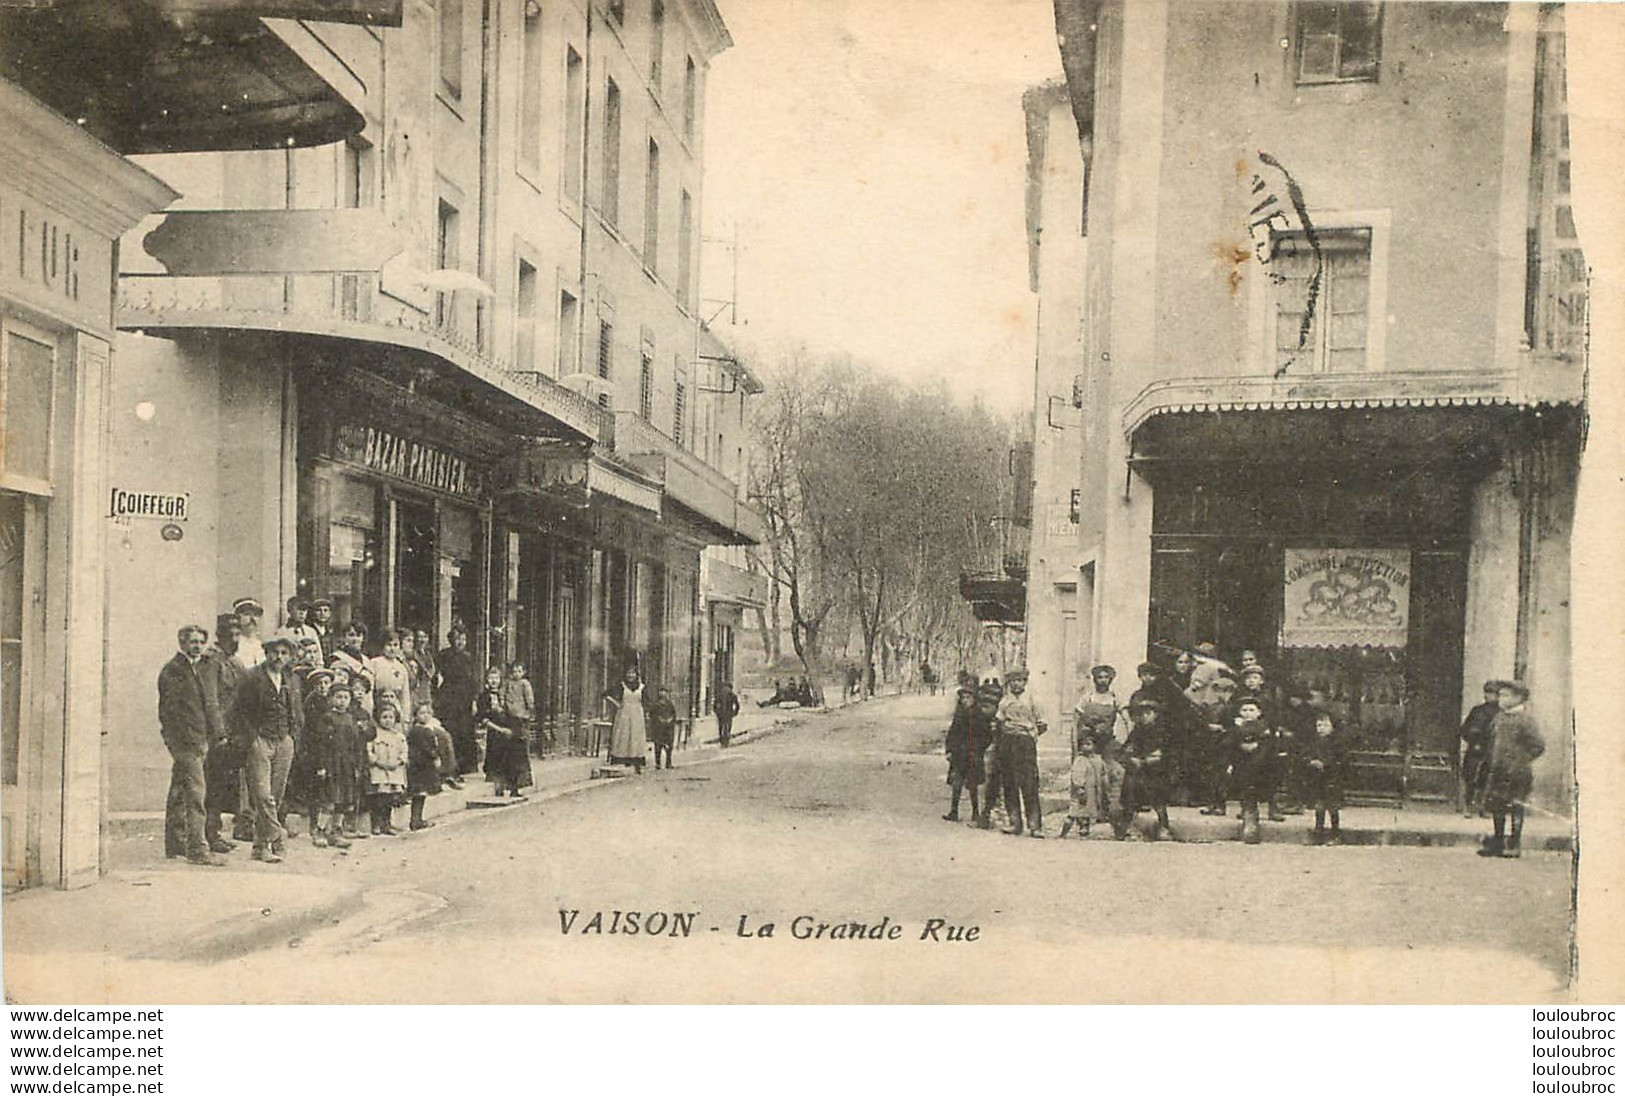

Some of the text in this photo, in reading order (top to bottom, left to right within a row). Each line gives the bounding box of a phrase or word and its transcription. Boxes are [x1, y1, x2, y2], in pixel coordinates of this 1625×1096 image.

[364, 427, 406, 478] BAZAR
[409, 443, 467, 494] PARISIEN
[117, 491, 185, 517] COIFFEUR
